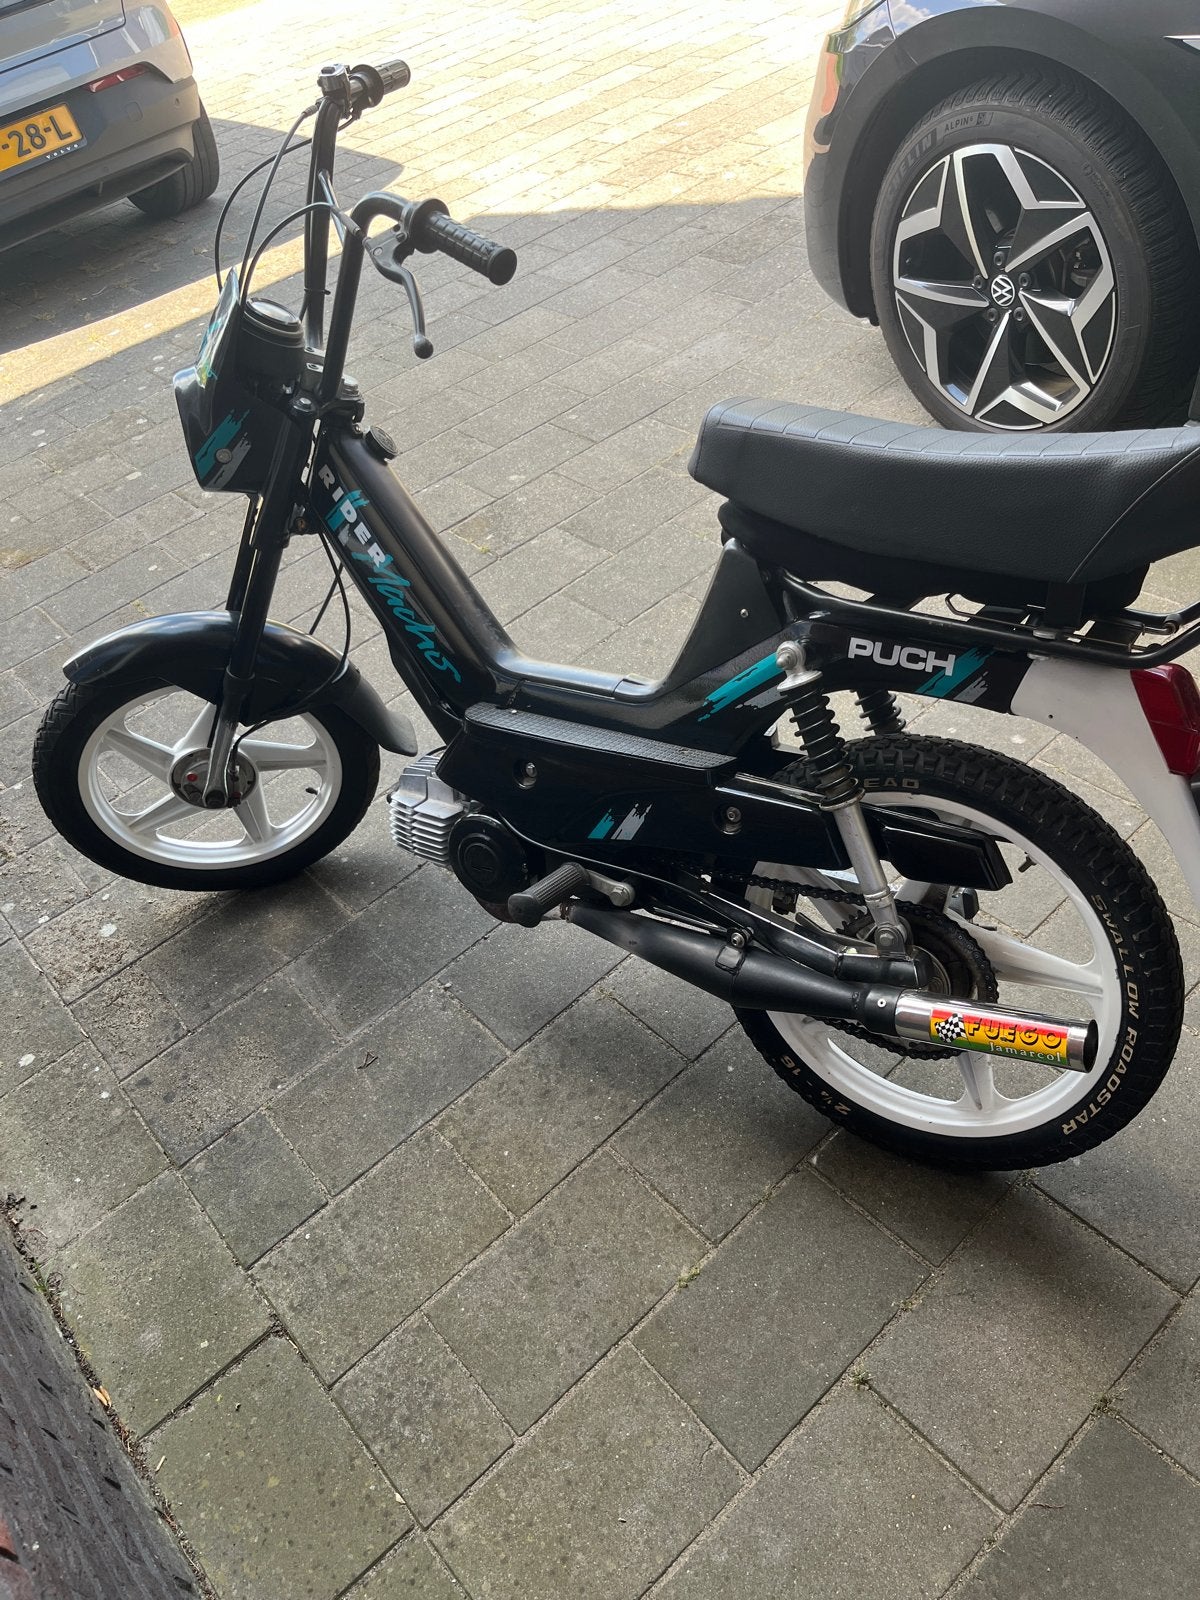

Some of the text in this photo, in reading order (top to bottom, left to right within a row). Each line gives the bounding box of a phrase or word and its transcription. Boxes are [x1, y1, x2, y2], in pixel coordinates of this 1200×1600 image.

[45, 143, 79, 159] VOLVO
[318, 464, 386, 568] RIDER
[848, 637, 956, 676] PUCH
[863, 777, 920, 789] EAD
[1061, 894, 1139, 1136] SWALLOW ROADSTAR
[967, 1018, 1062, 1049] FUEGO
